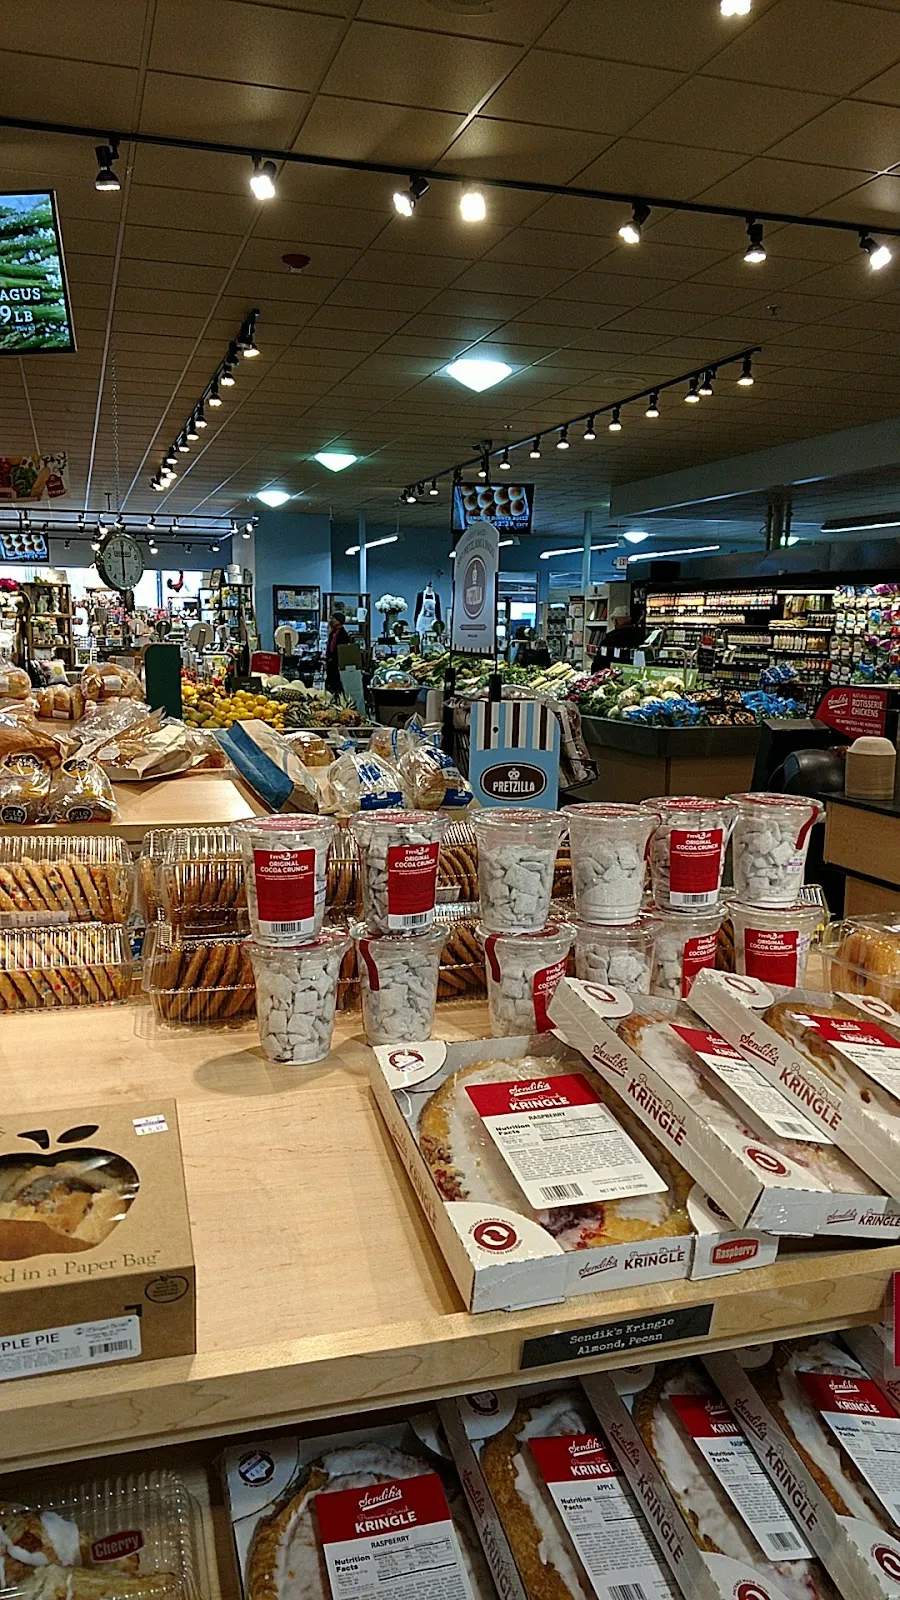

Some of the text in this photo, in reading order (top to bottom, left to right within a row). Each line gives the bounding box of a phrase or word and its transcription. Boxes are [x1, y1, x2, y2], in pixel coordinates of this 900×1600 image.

[14, 310, 33, 323] LB
[851, 707, 879, 718] CHICKENS
[492, 780, 535, 793] PRETZILLA
[282, 865, 309, 873] CRUNCH
[739, 1031, 779, 1066] Sendik's
[592, 1041, 629, 1078] Sendik's
[508, 1081, 552, 1096] Sendik's
[508, 1096, 571, 1111] KRINGLE
[779, 1067, 843, 1131] KRINGLE
[627, 1078, 688, 1147] KRINGLE
[495, 1123, 531, 1132] Nutrition
[858, 1215, 900, 1228] KRINGLE
[715, 1244, 758, 1261] Raspberry
[23, 1268, 40, 1281] in
[47, 1267, 57, 1277] a
[64, 1257, 118, 1276] Paper
[123, 1251, 161, 1267] Bag
[624, 1252, 685, 1270] KRINGLE
[625, 1318, 675, 1334] Kringle
[35, 1332, 60, 1346] PIE
[577, 1332, 663, 1355] Almond, Pecan
[834, 1400, 880, 1414] KRINGLE
[765, 1445, 818, 1532] KRINGLE
[358, 1485, 402, 1511] Sendik's
[354, 1510, 417, 1534] KRINGLE
[636, 1473, 685, 1565] KRINGLE
[95, 1535, 139, 1558] Cherry
[370, 1534, 410, 1550] RASPBERRY
[334, 1553, 371, 1566] Nutrition
[336, 1563, 359, 1573] Facts
